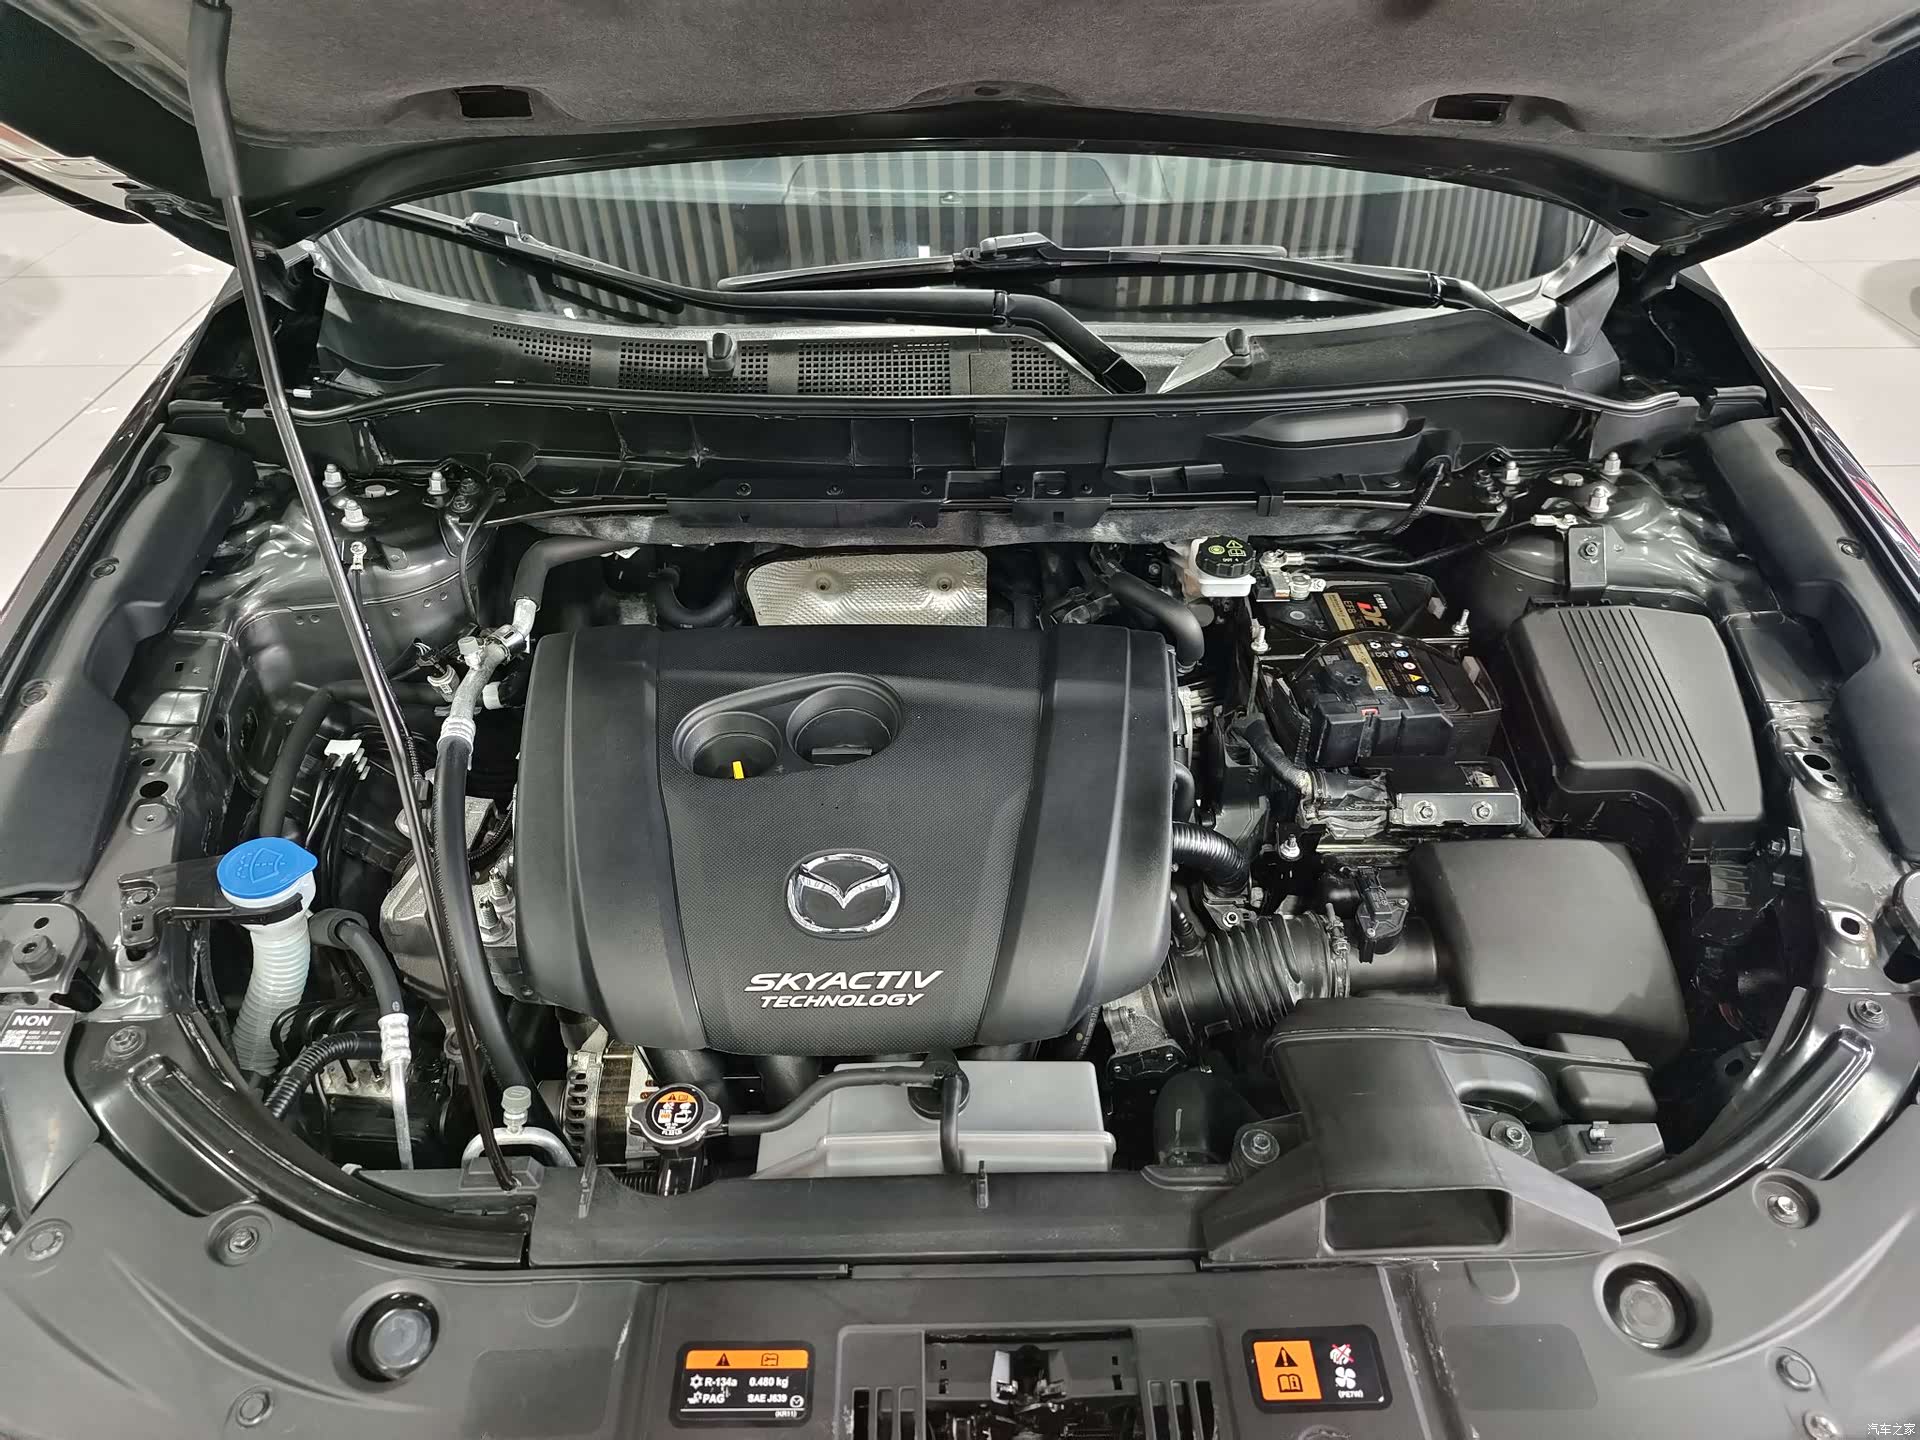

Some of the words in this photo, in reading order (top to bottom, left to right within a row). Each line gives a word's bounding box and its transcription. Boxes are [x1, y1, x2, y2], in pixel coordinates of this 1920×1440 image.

[1343, 600, 1357, 613] EFB
[744, 970, 944, 992] SKYACTIV
[761, 993, 924, 1008] TECHNOLOGY
[12, 1015, 53, 1027] NON
[704, 1376, 738, 1387] R-134a
[775, 1376, 789, 1388] kg
[702, 1393, 725, 1404] PAG
[747, 1393, 766, 1403] SAE
